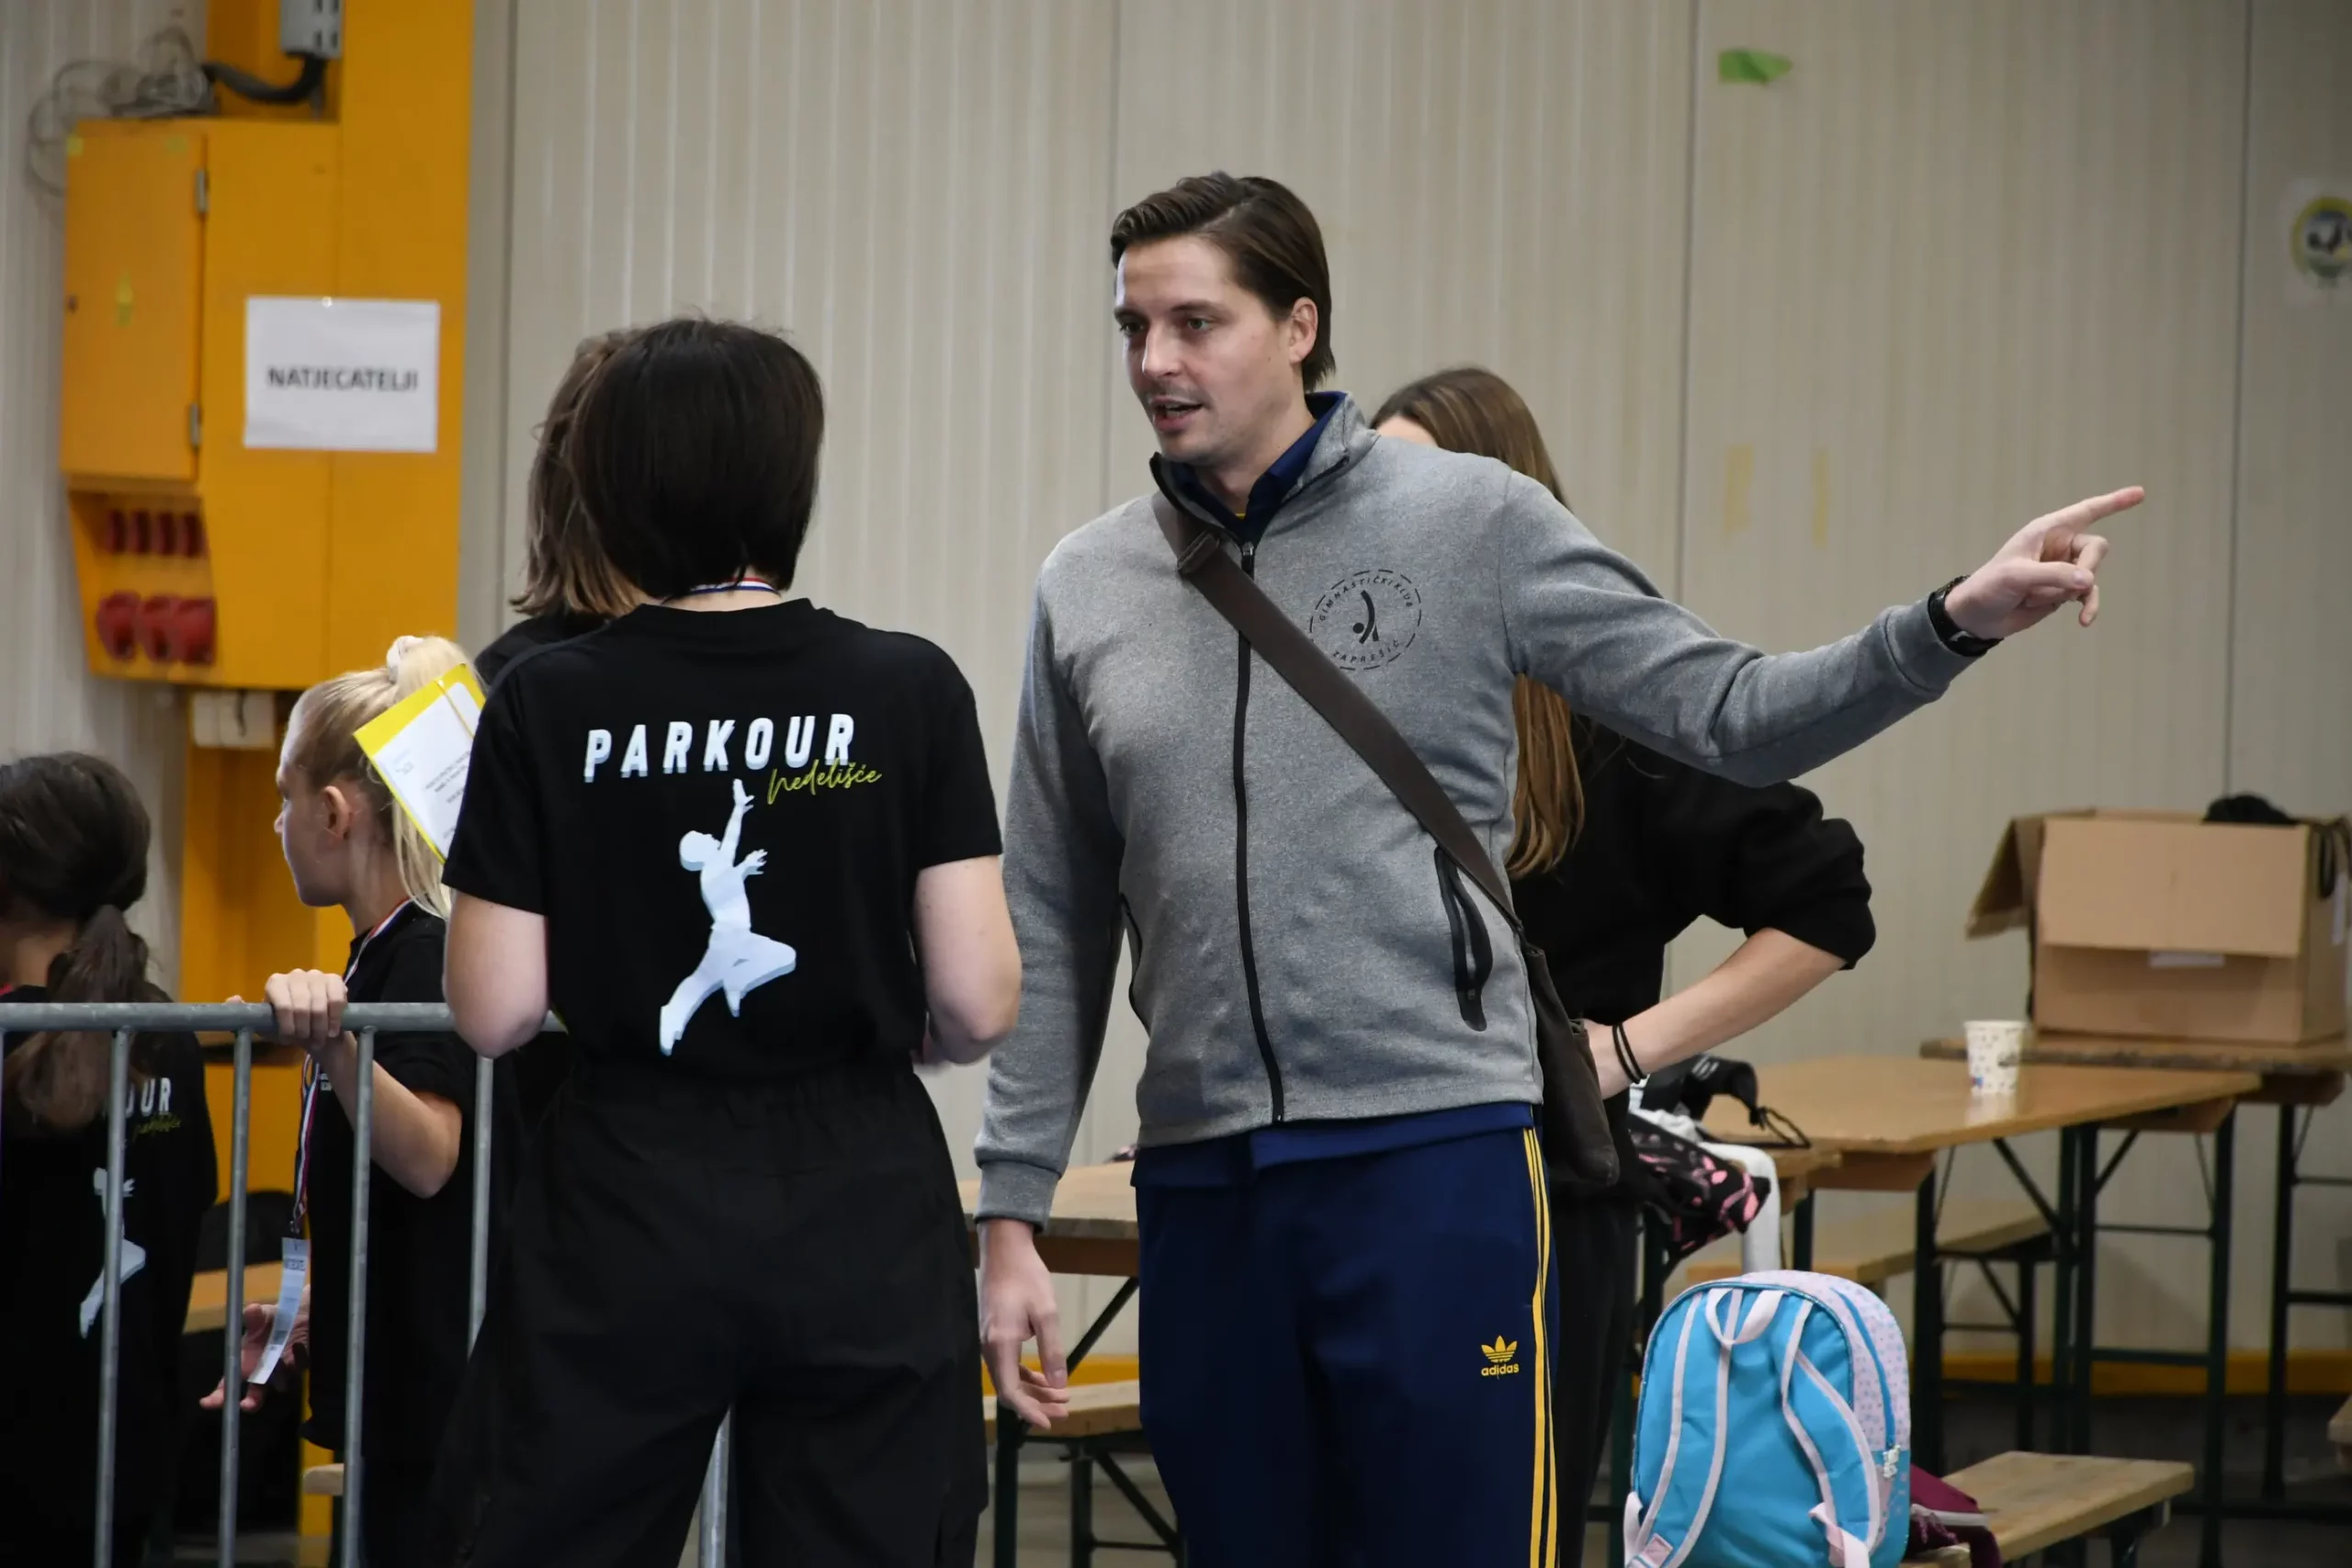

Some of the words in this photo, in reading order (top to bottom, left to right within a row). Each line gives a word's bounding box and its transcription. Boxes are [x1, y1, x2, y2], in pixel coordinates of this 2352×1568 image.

[267, 367, 419, 390] NATJECATELJI
[1394, 582, 1413, 607] KLUB
[583, 713, 855, 784] PARKOUR
[1481, 1363, 1519, 1376] adidas
